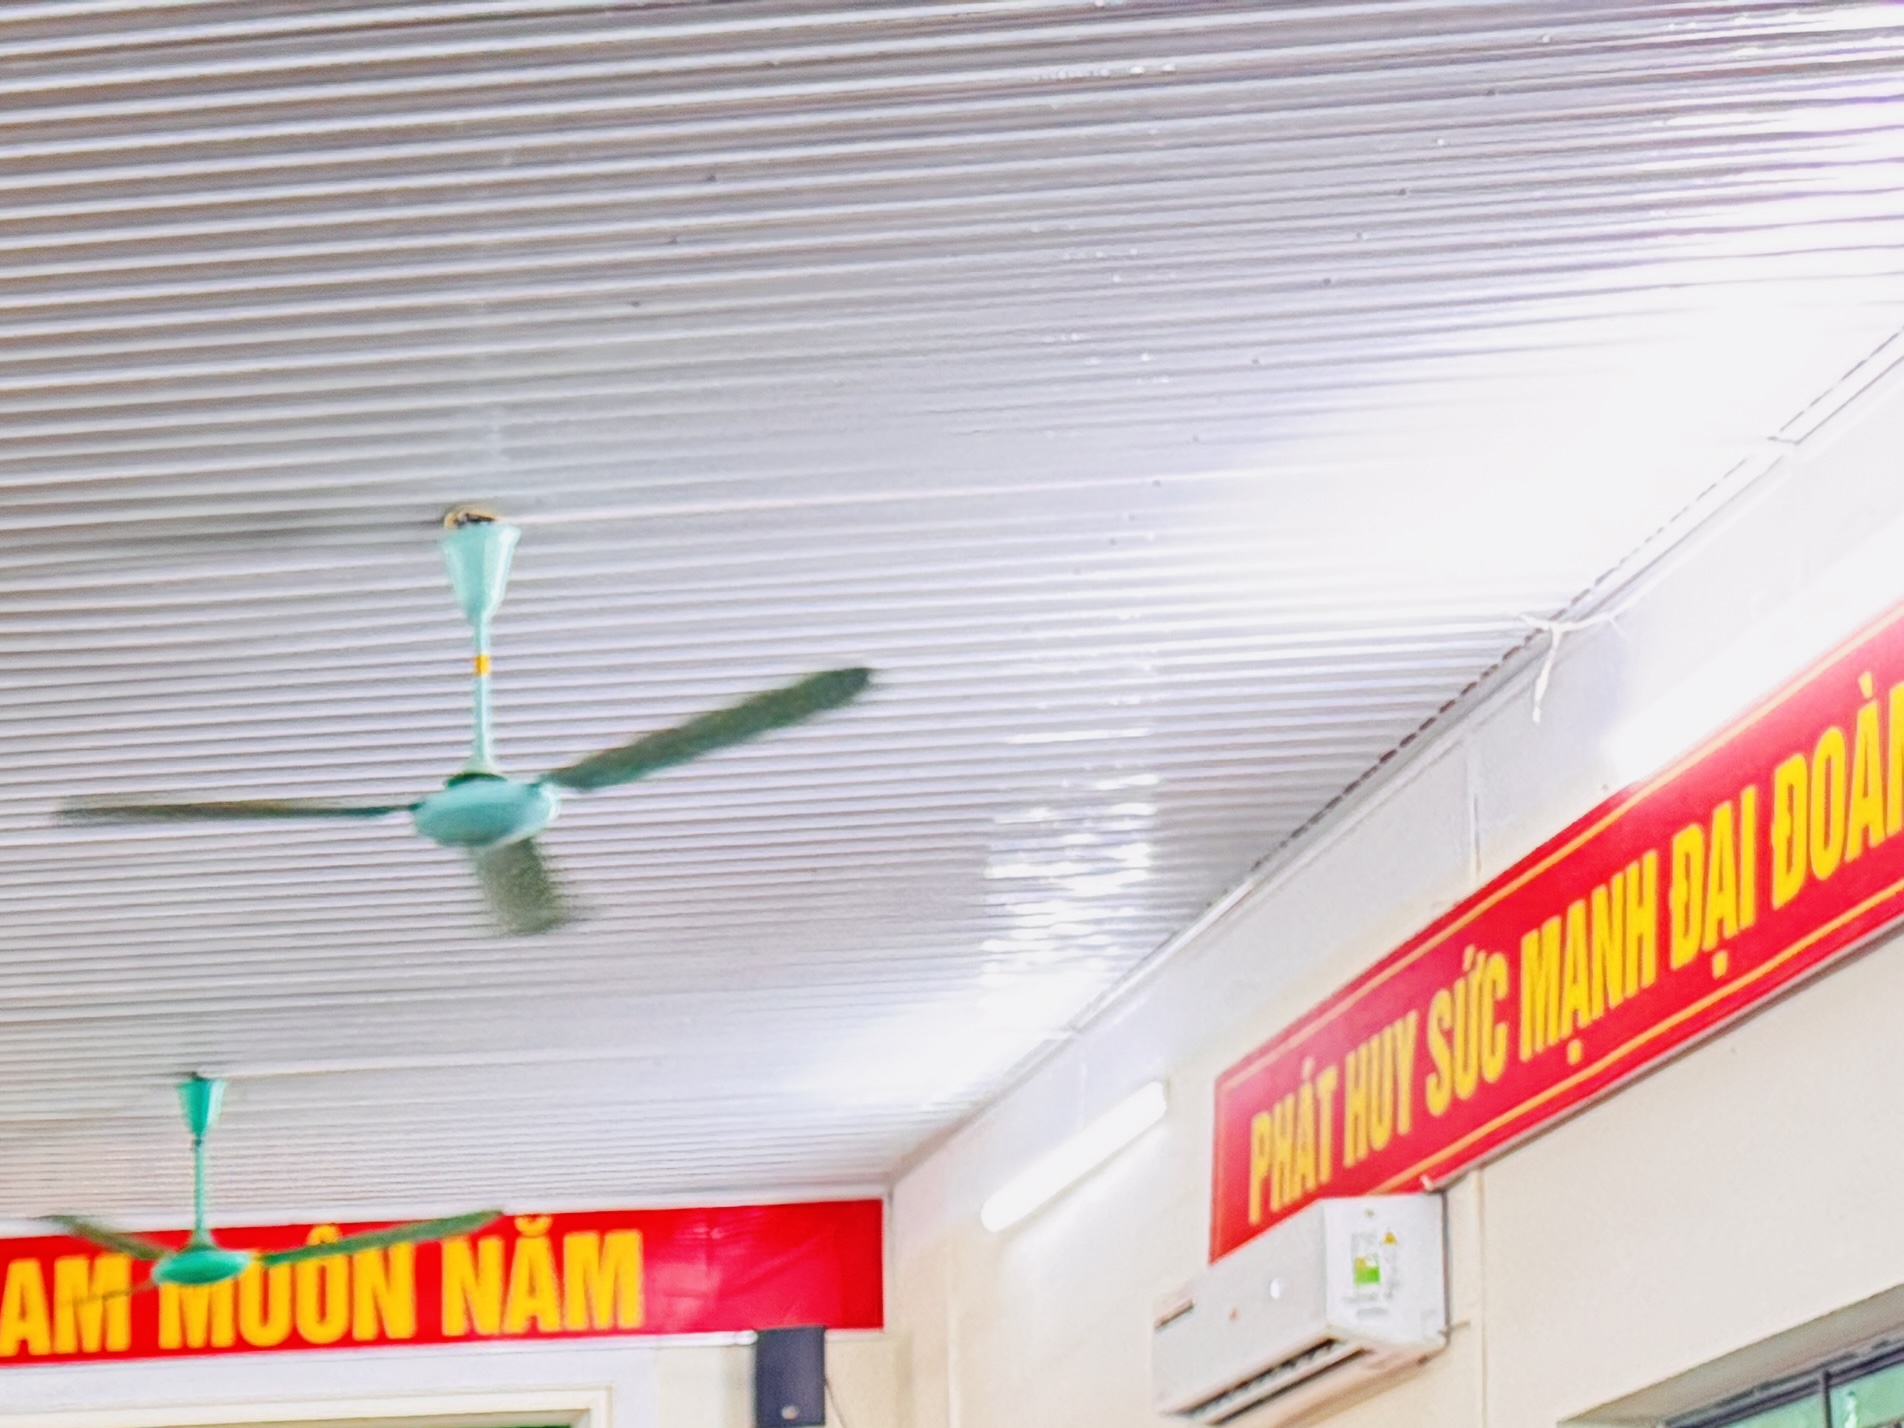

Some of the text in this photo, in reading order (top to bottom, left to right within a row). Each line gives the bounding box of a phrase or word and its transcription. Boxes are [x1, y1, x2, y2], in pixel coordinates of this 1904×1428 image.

[1247, 1056, 1339, 1226] PHÁT
[1343, 1009, 1420, 1169] HUY
[1424, 943, 1510, 1118] SỨC
[1518, 849, 1659, 1066] MẠNH
[1668, 783, 1759, 979] ĐẠI
[157, 1222, 418, 1350] MUÔN
[441, 1214, 645, 1337] NĂM
